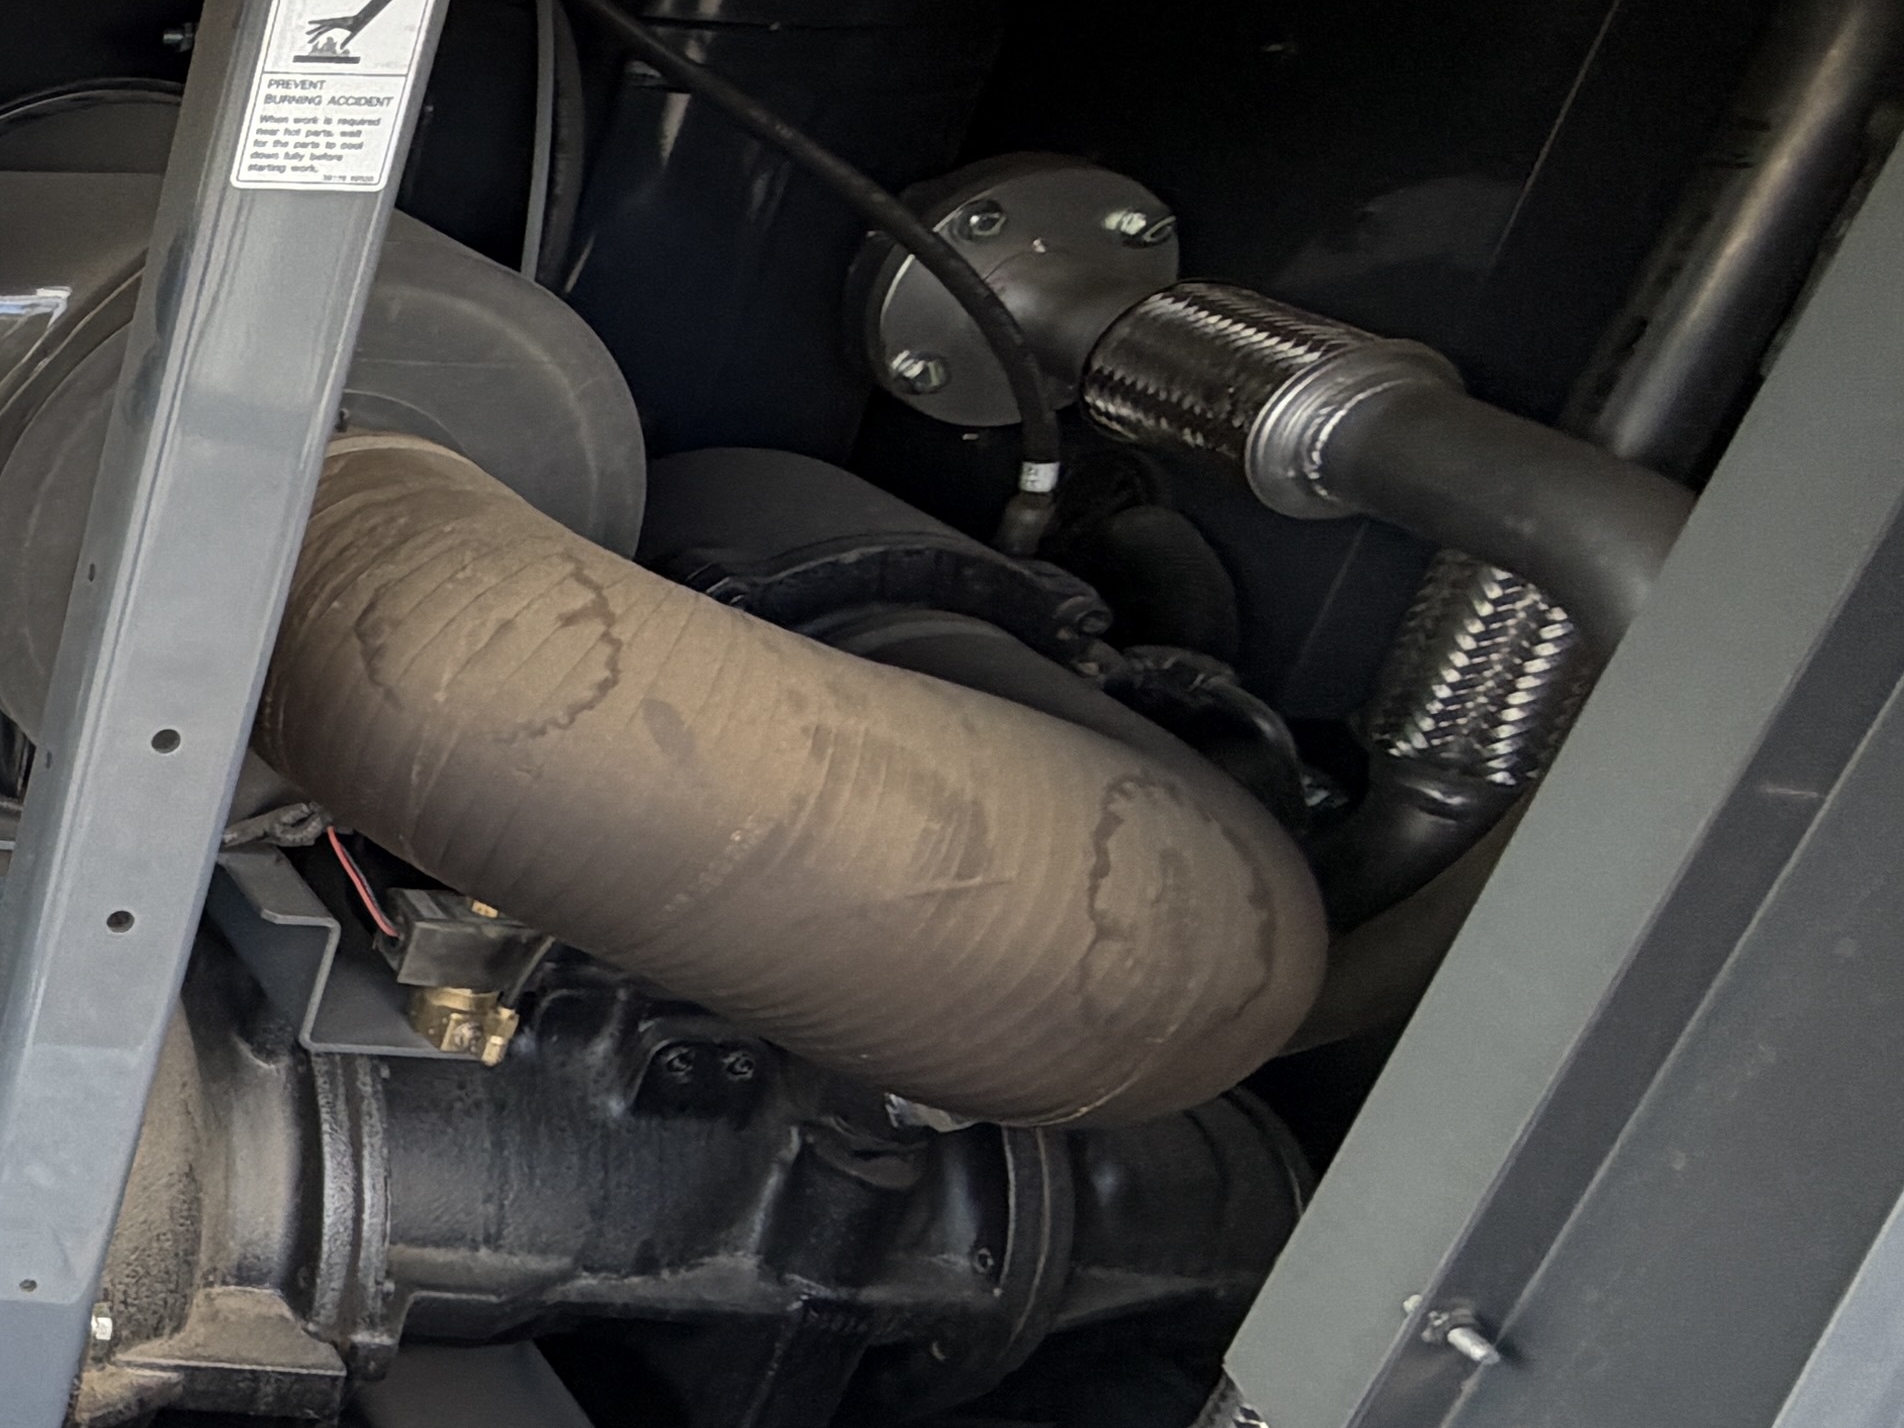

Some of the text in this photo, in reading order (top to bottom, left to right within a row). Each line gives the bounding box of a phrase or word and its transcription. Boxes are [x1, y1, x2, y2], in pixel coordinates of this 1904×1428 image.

[267, 79, 326, 90] PREVENT
[264, 94, 394, 107] BURNING ACCIDENT
[259, 114, 289, 124] When
[323, 116, 332, 125] is
[337, 118, 381, 126] required
[283, 128, 301, 136] hot
[253, 139, 268, 147] for
[272, 140, 289, 148] the
[325, 141, 336, 149] to
[340, 141, 363, 150] cool
[283, 152, 305, 162] fully
[309, 153, 343, 161] before
